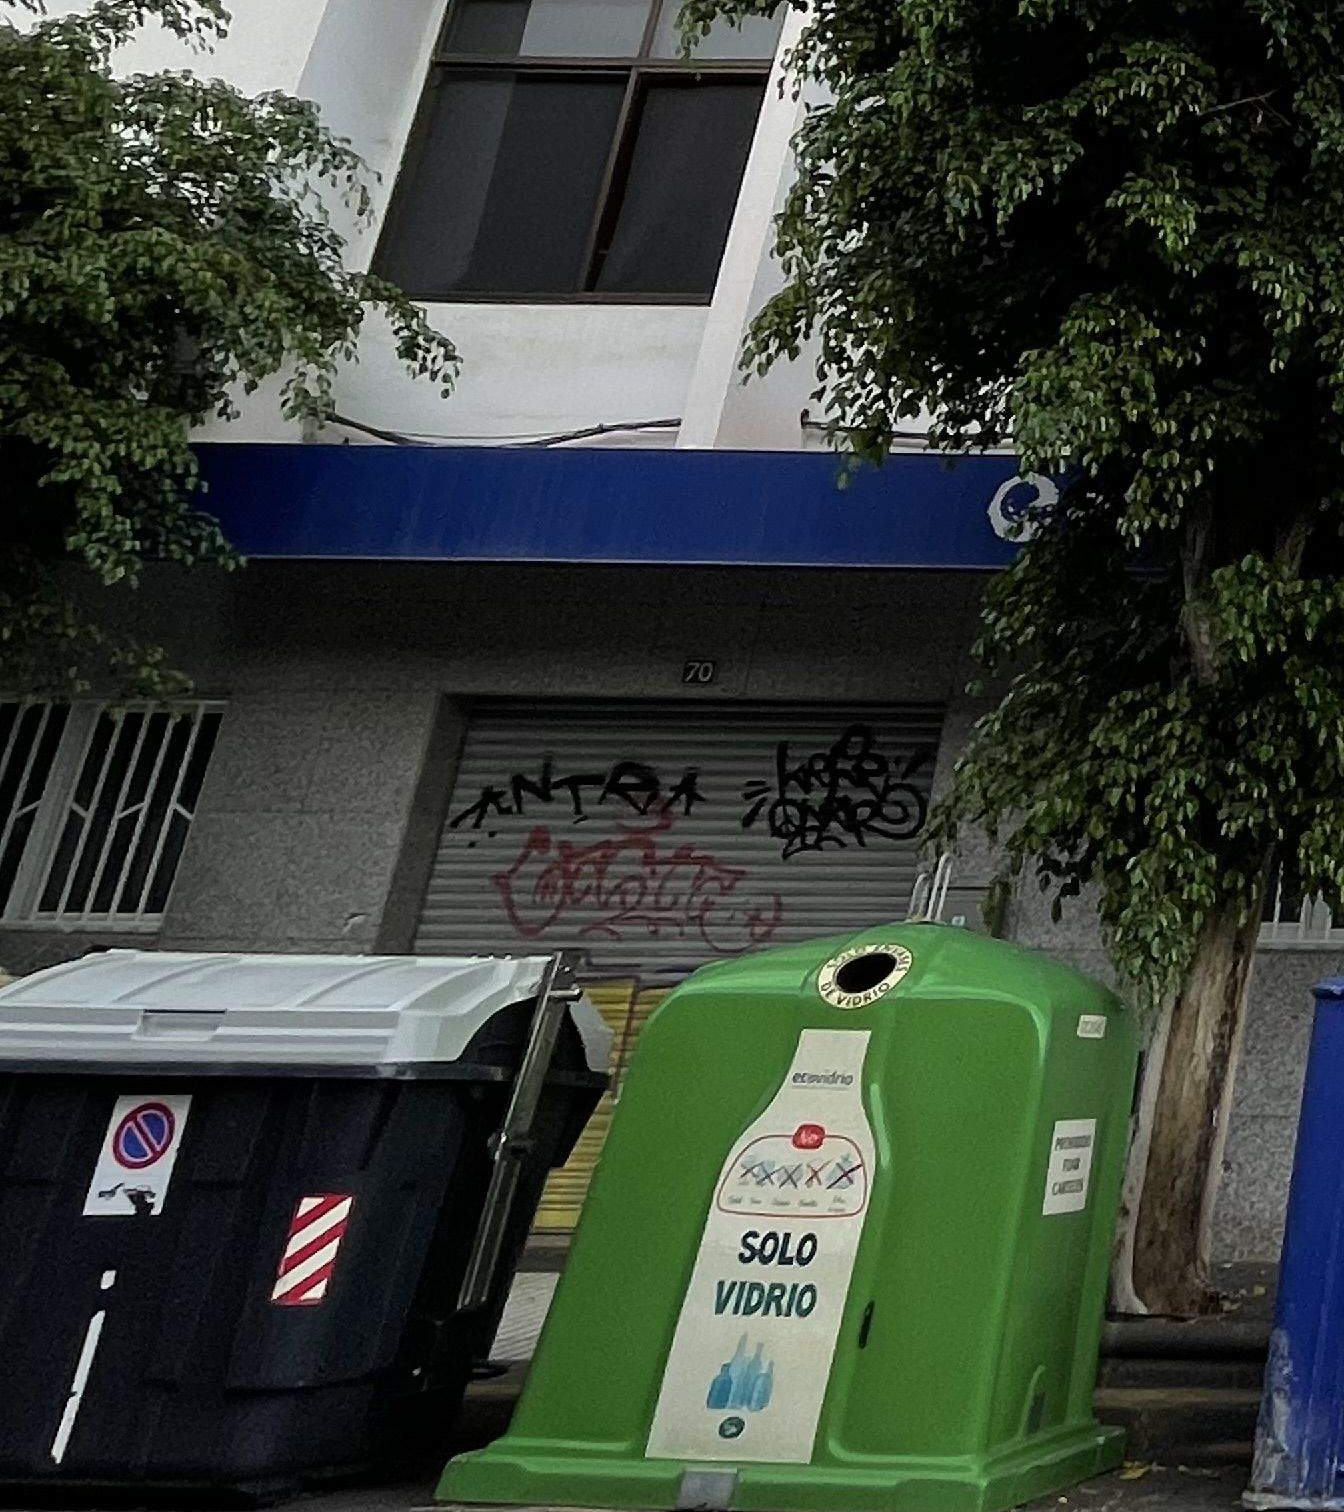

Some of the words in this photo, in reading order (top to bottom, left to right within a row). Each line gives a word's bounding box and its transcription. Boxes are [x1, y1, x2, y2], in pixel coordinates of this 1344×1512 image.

[684, 662, 713, 682] 70
[738, 1230, 818, 1267] SOLO
[714, 1280, 818, 1318] VIDRIO
